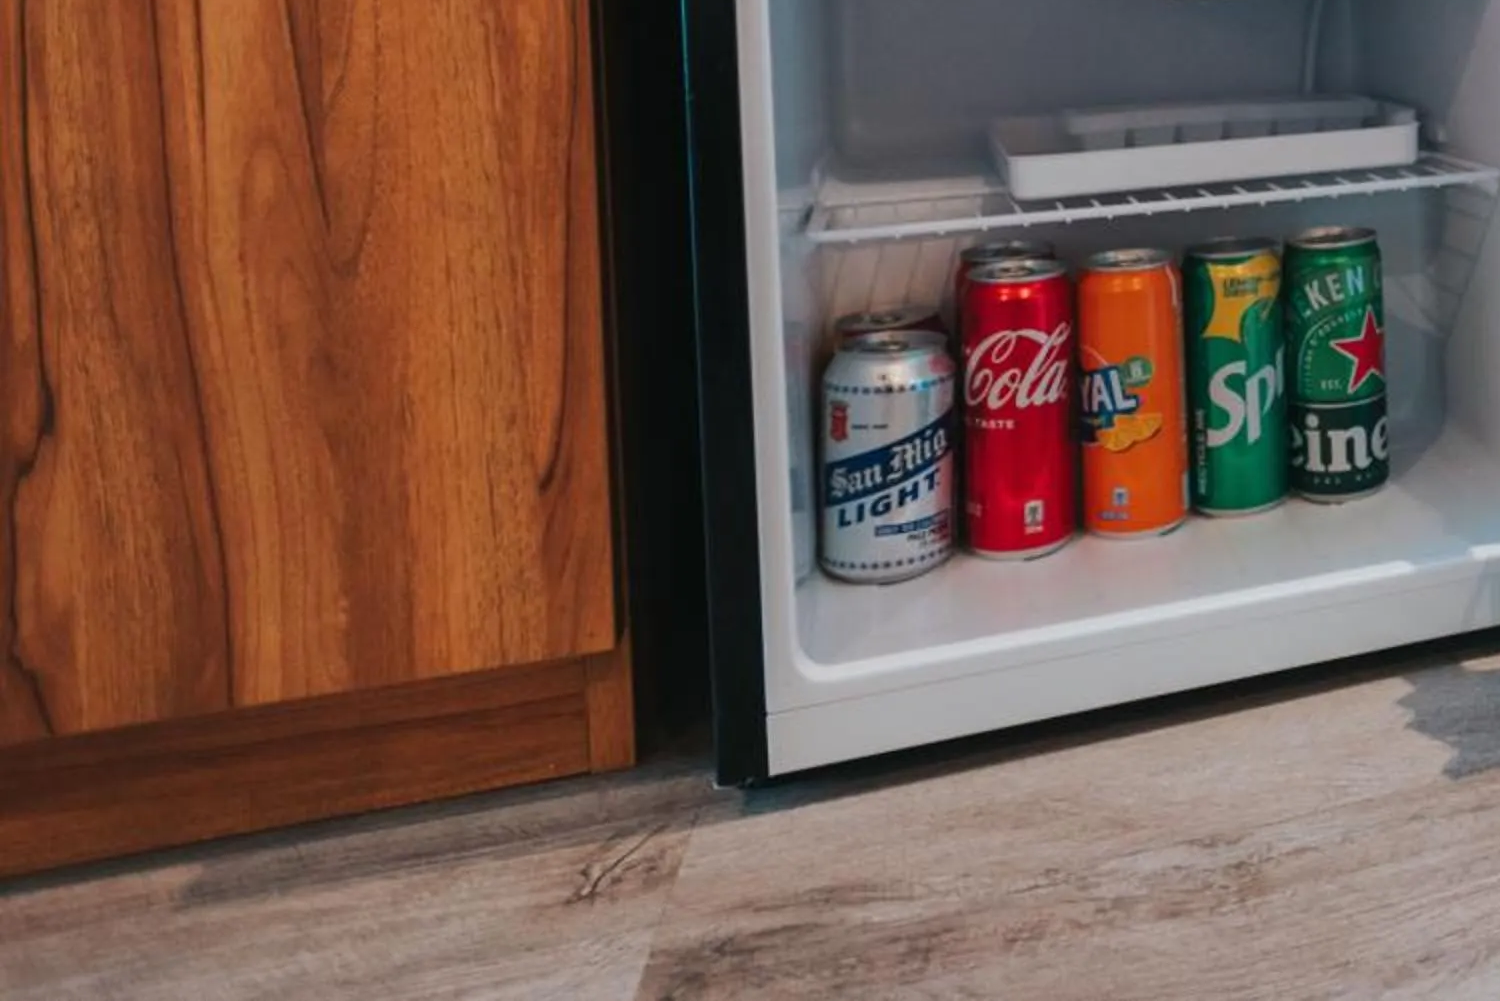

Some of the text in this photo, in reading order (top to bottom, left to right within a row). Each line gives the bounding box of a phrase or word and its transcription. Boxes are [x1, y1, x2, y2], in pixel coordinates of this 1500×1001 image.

[964, 321, 1071, 410] Cola
[831, 464, 882, 498] San
[837, 466, 941, 529] LIGHT
